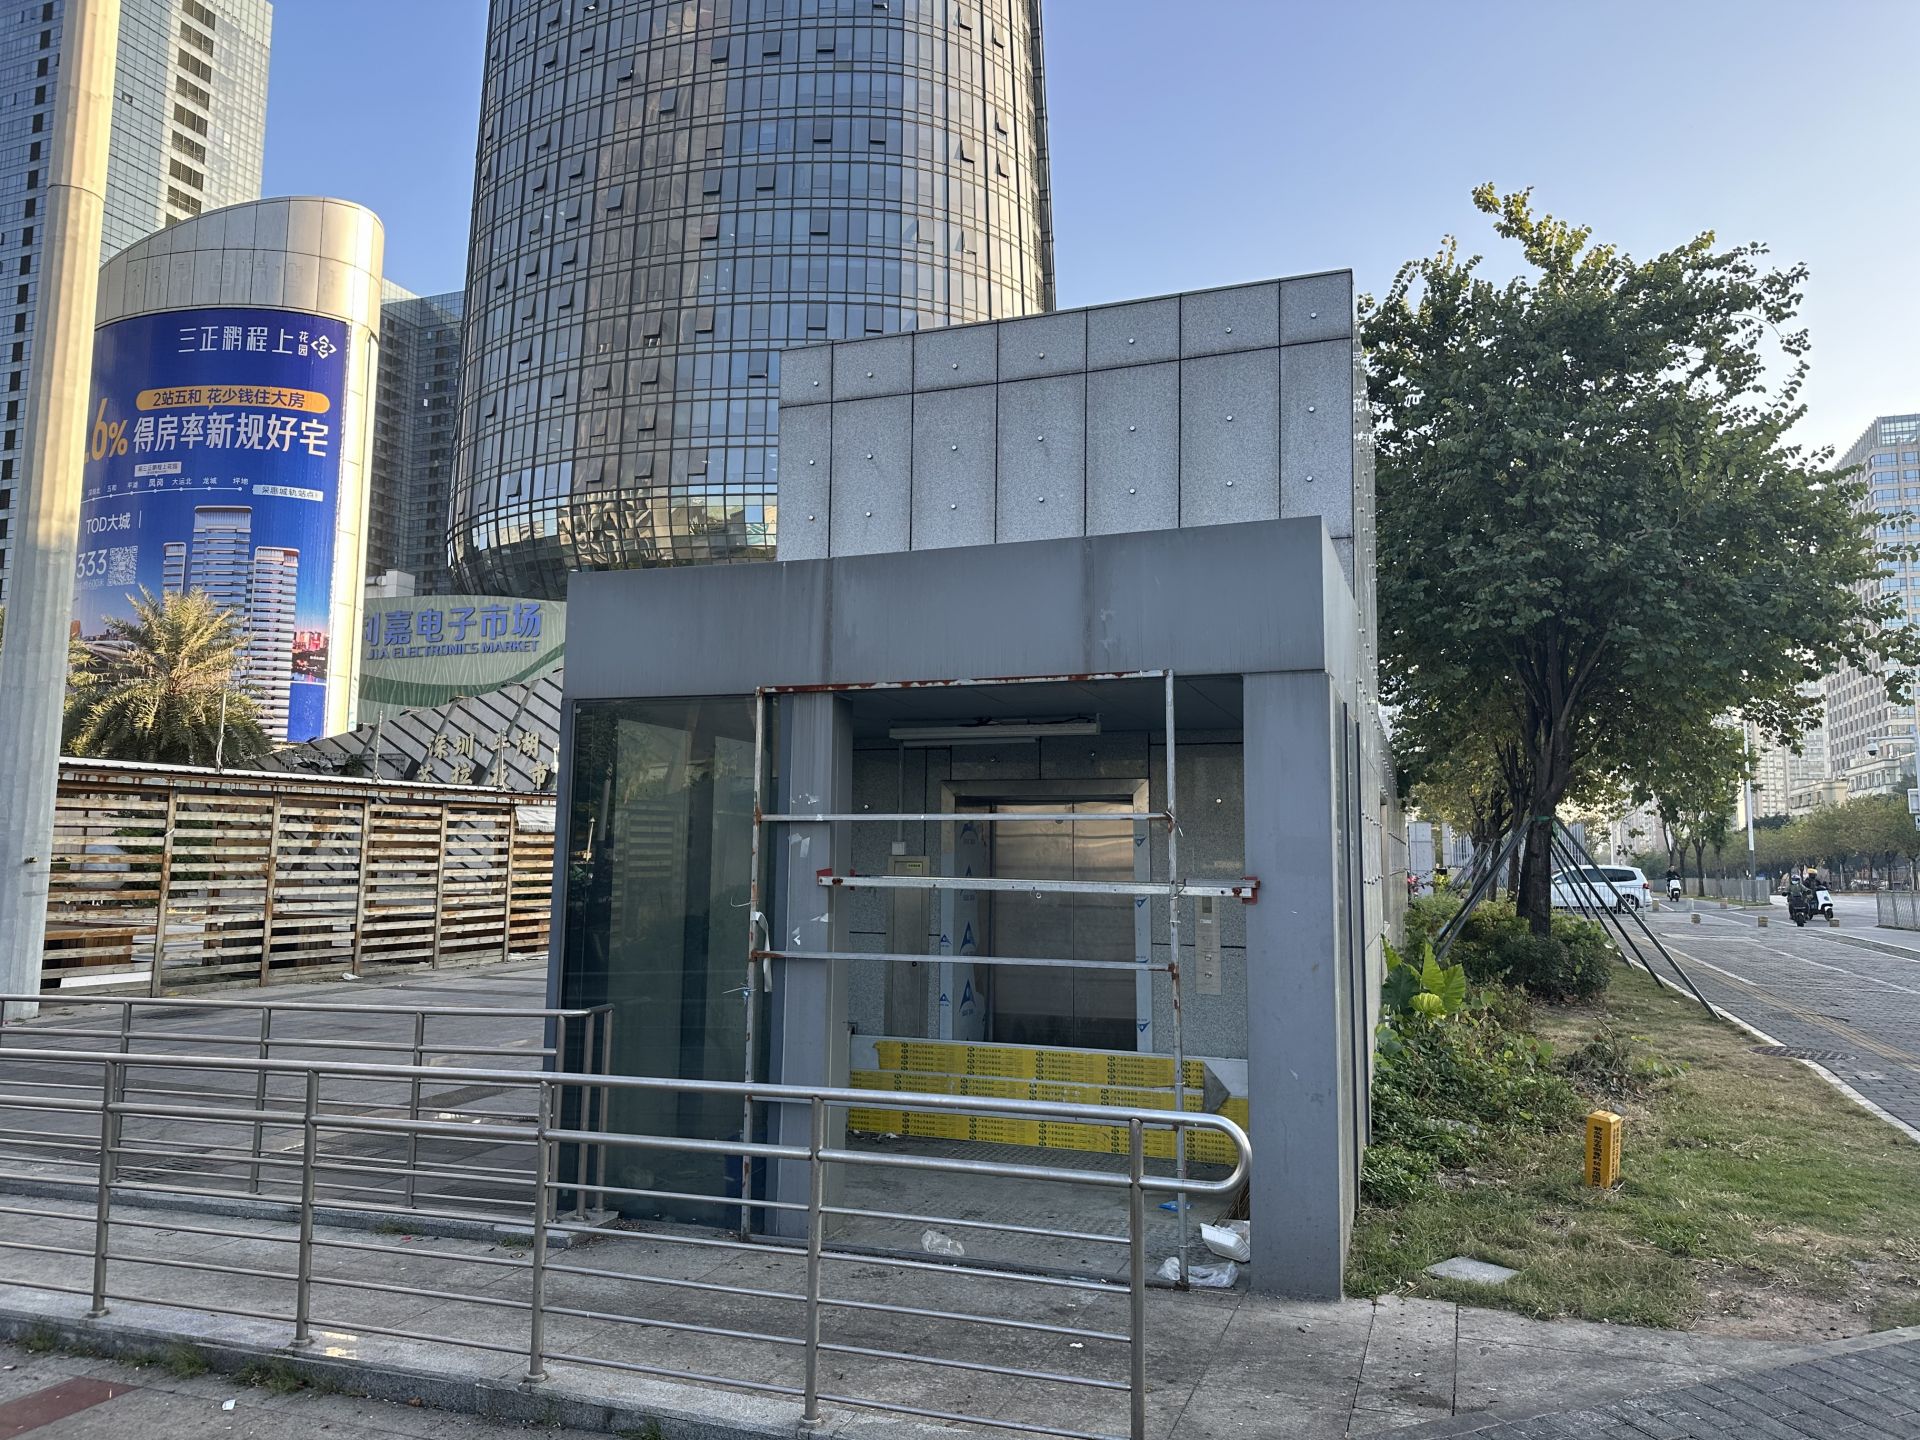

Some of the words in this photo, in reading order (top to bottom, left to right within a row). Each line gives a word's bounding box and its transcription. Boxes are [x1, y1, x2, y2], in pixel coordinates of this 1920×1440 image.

[178, 325, 294, 354] 三正鹏程上
[298, 331, 308, 356] 花园
[153, 389, 203, 407] 2站五和
[208, 387, 305, 409] 花少钱住大房
[133, 412, 329, 457] 得房率新规好宅
[392, 642, 479, 659] ELECTRONICS
[481, 640, 540, 654] MARKET
